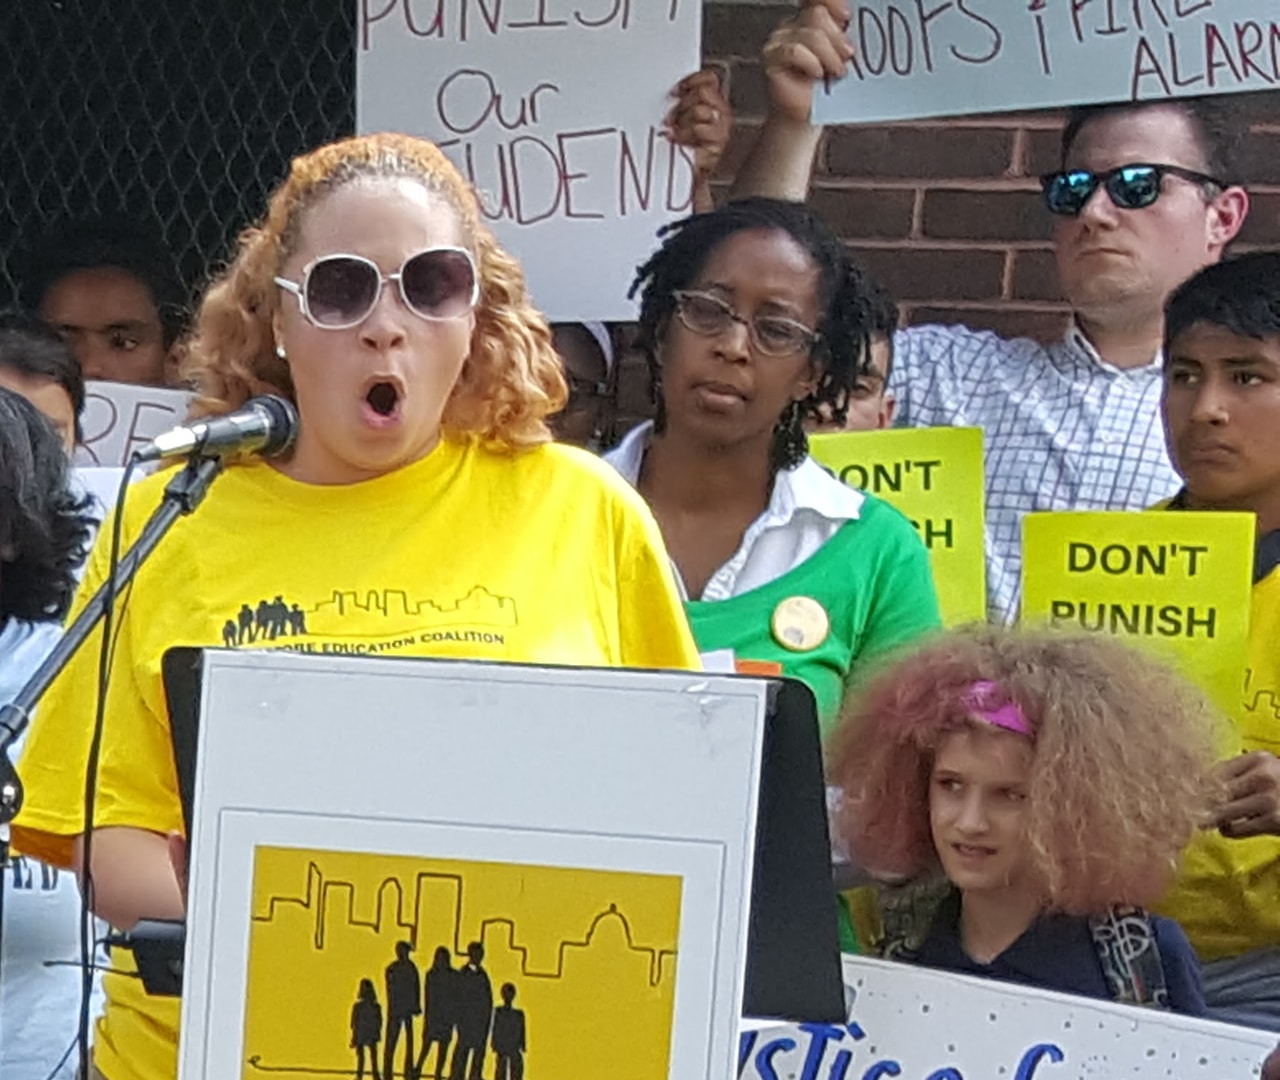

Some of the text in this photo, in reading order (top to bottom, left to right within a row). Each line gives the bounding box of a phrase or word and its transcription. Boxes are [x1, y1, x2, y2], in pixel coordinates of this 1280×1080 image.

[824, 0, 1002, 95] OOFS
[1131, 18, 1280, 100] ALAR
[437, 68, 560, 134] Our
[823, 459, 942, 494] ON'T
[1067, 542, 1209, 578] DON'T
[419, 630, 505, 645] COALITION
[1050, 599, 1217, 639] PUNISH
